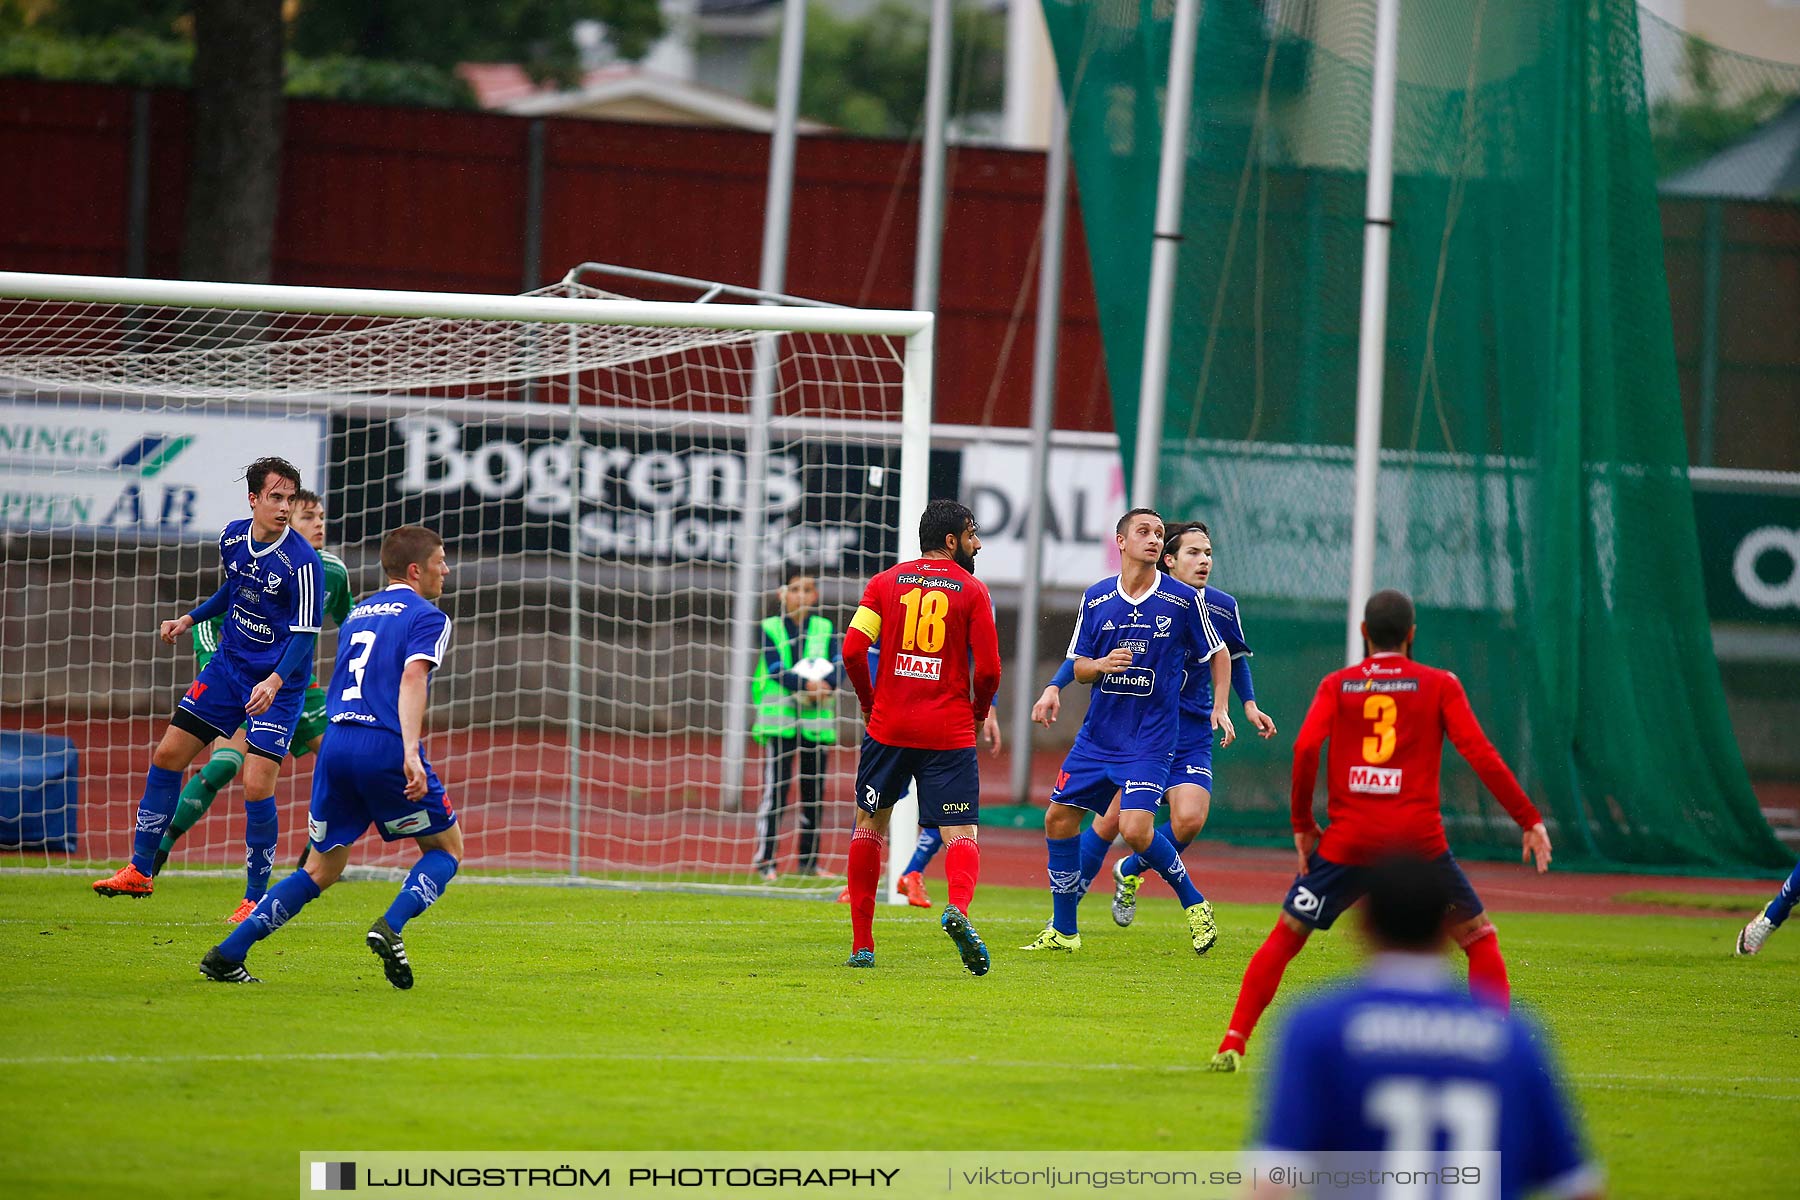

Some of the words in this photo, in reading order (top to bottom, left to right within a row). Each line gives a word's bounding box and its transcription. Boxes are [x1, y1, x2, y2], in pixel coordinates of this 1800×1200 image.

[398, 415, 800, 516] Bogrens
[103, 482, 198, 525] AB
[578, 507, 859, 572] salonger
[900, 588, 949, 653] 18
[341, 630, 376, 702] 3
[896, 655, 940, 674] MAXI
[1105, 673, 1150, 688] Furhoffs
[1362, 694, 1397, 765] 3
[1351, 769, 1400, 787] MAXI
[942, 802, 970, 813] onyx
